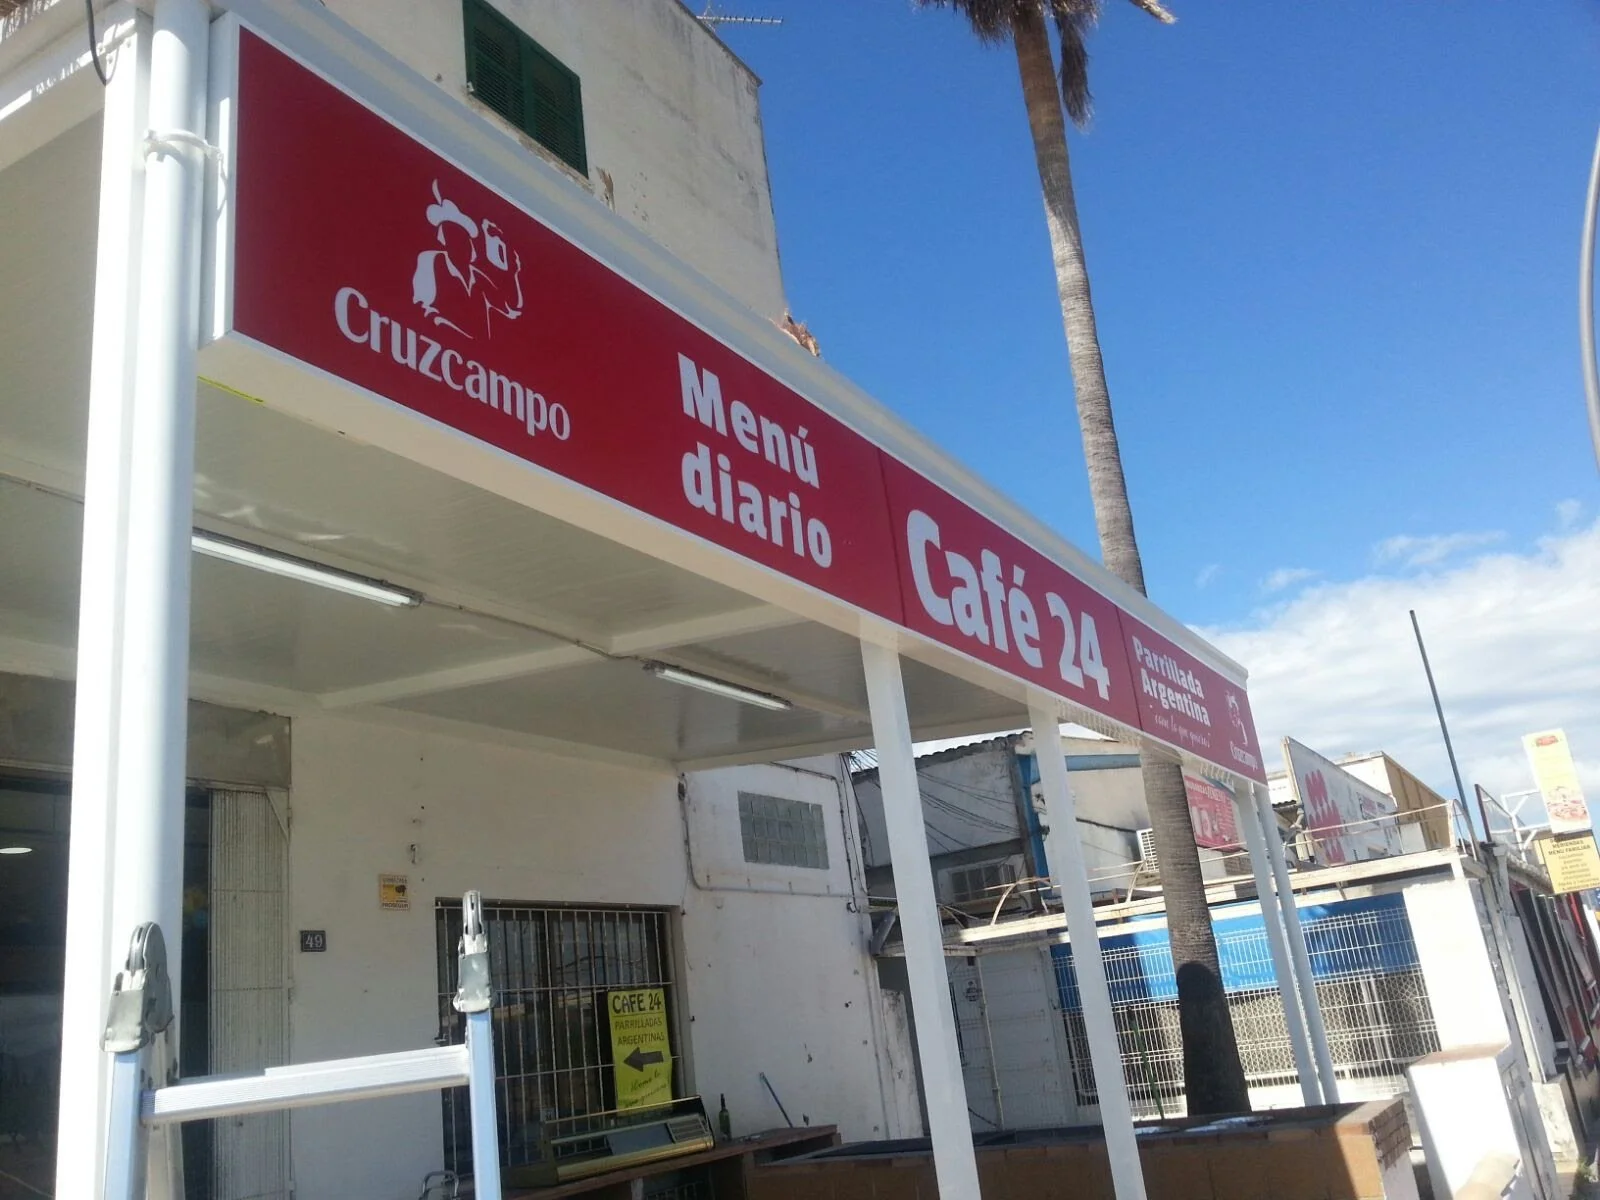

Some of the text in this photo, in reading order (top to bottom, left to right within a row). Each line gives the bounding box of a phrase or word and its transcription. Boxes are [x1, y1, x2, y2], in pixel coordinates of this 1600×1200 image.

[334, 286, 571, 441] Cruzcampo
[677, 352, 820, 489] Menú
[681, 441, 833, 568] diario
[906, 509, 1110, 701] Café 24
[1132, 635, 1204, 699] Parrillada
[1141, 668, 1211, 727] Argentina
[305, 934, 323, 948] 49
[612, 992, 661, 1014] CAFE 24
[615, 1017, 663, 1030] PARRILLADAS
[617, 1031, 665, 1046] ARGENTINAS
